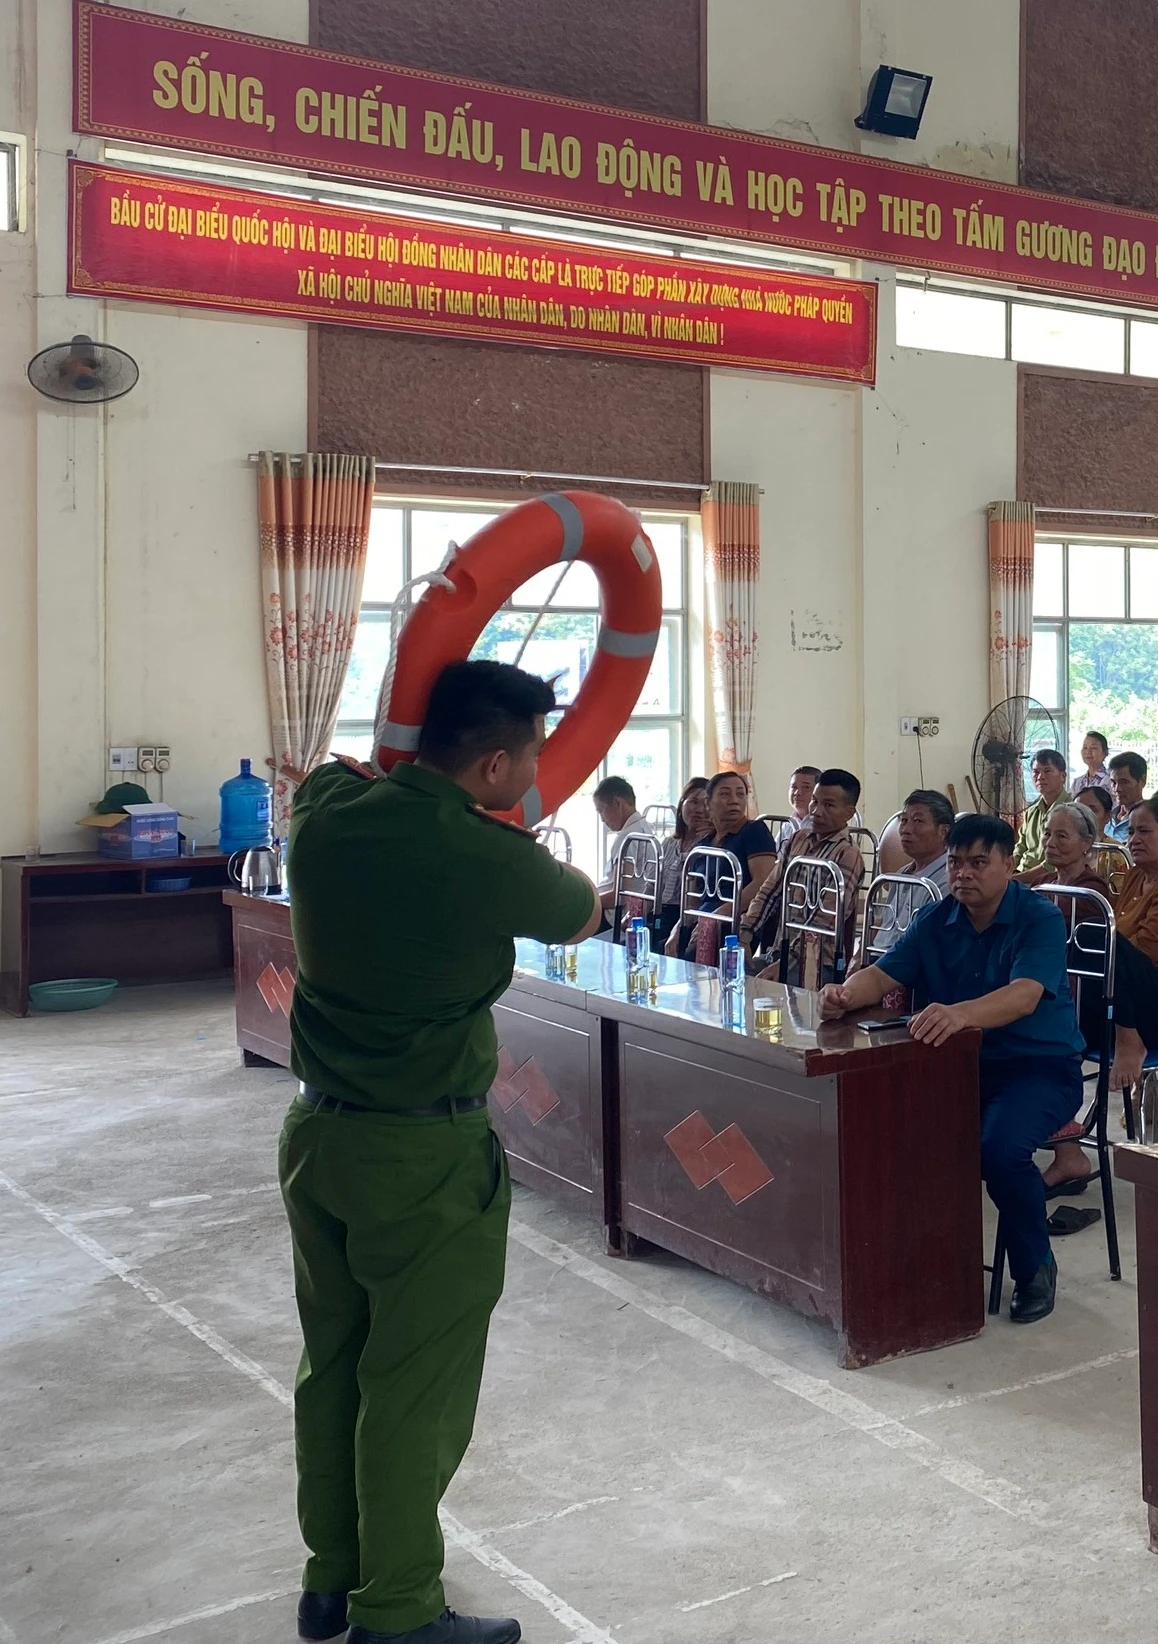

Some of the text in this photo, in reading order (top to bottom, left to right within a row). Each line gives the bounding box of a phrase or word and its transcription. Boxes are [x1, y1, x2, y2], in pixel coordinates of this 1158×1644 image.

[152, 52, 275, 133] SỐNG,
[295, 85, 406, 149] CHIẾN
[423, 102, 503, 171] ĐẤU,
[520, 128, 581, 179] LAO
[596, 138, 682, 198] ĐỘNG
[695, 155, 734, 206] VÀ
[747, 170, 803, 223] HỌC
[816, 178, 866, 233] TẬP
[878, 194, 942, 241] THEO
[952, 199, 1004, 252] TẤM
[1015, 219, 1093, 267] GƯƠNG
[1103, 235, 1146, 281] ĐẠO
[110, 189, 141, 228] BẦU
[144, 195, 165, 231] CỬ
[167, 205, 192, 240] ĐẠI
[196, 202, 228, 240] BIỂU
[232, 209, 269, 246] QUỐC
[272, 216, 295, 255] HỘI
[298, 220, 316, 252] VÀ
[319, 227, 341, 260] ĐẠI
[345, 223, 374, 260] BIỂU
[378, 232, 399, 268] HỘI
[402, 232, 437, 269] ĐỒNG
[440, 243, 474, 274] NHÂN
[477, 246, 502, 278] DÂN
[505, 250, 529, 282] CÁC
[532, 251, 555, 284] CẤP
[558, 258, 572, 288] LÀ
[574, 265, 603, 295] TRỰC
[606, 263, 629, 297] TIẾP
[632, 268, 654, 298] GÓP
[656, 271, 687, 303] PHẦN
[687, 278, 709, 306] XÂY
[764, 289, 792, 316] NƯỚC
[793, 292, 819, 320] PHÁP
[297, 265, 724, 346] XÃ HỘI CHỦ NGHĨA VIỆT NAM CỦA NHÂN DÂN, DO NHÂN DÂN, VÌ NHÂN DÂN !
